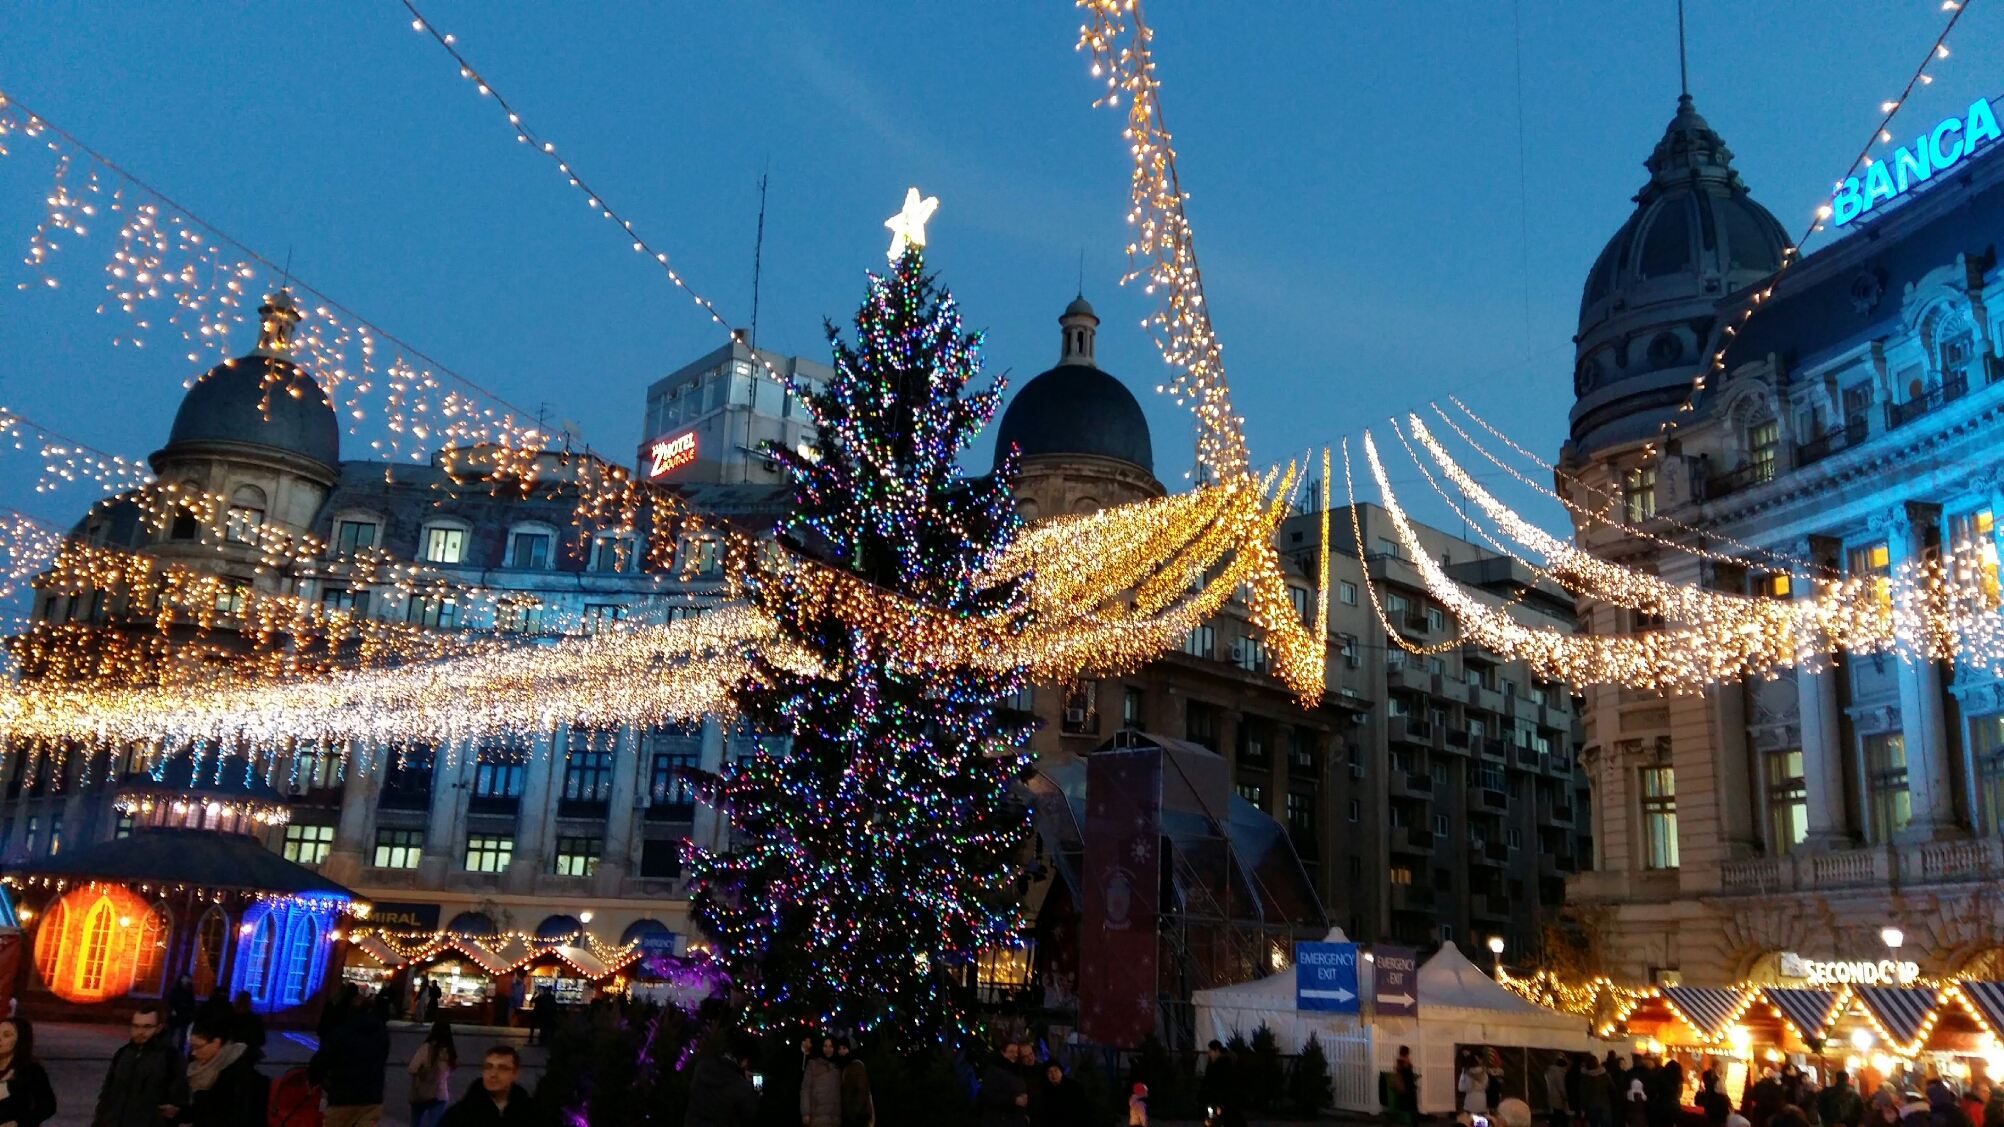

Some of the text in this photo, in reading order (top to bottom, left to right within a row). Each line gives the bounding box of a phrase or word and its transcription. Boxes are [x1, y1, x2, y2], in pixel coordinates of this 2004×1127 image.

[1833, 97, 2001, 227] BANCA
[662, 432, 695, 461] HOTEL
[369, 912, 421, 926] MIRAL
[1300, 952, 1355, 966] EMERGENCY
[1377, 956, 1415, 971] EMERGENCY
[1318, 967, 1337, 980] EXIT
[1390, 972, 1404, 985] EXIT
[1804, 960, 1877, 985] SECOND
